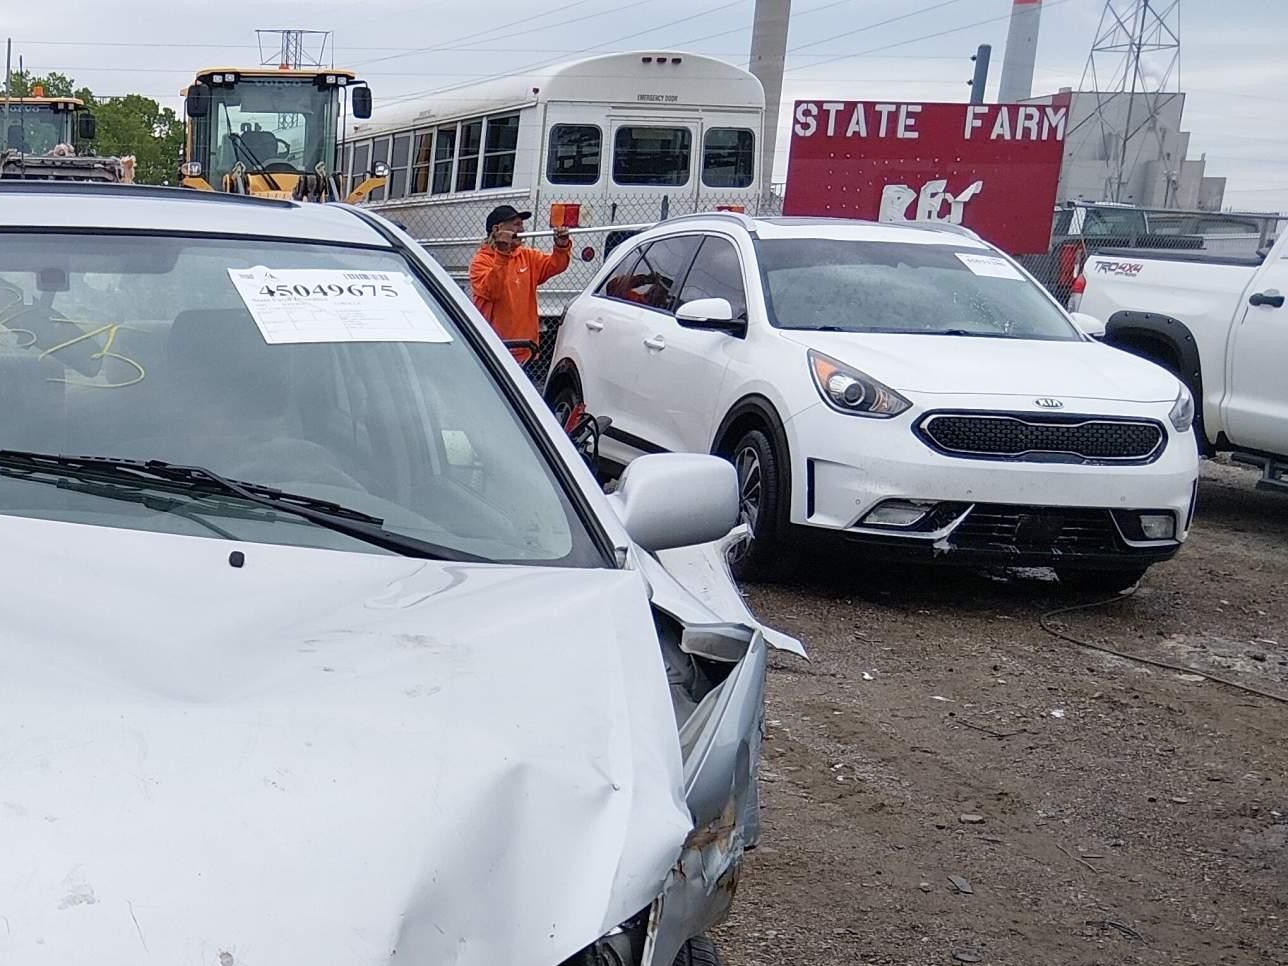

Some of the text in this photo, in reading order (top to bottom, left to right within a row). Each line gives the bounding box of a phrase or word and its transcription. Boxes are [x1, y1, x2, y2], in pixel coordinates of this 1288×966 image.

[637, 94, 664, 102] EMERGENCY
[794, 103, 1067, 141] STATE FARM
[259, 283, 399, 298] 45049675
[1036, 398, 1062, 408] KIA
